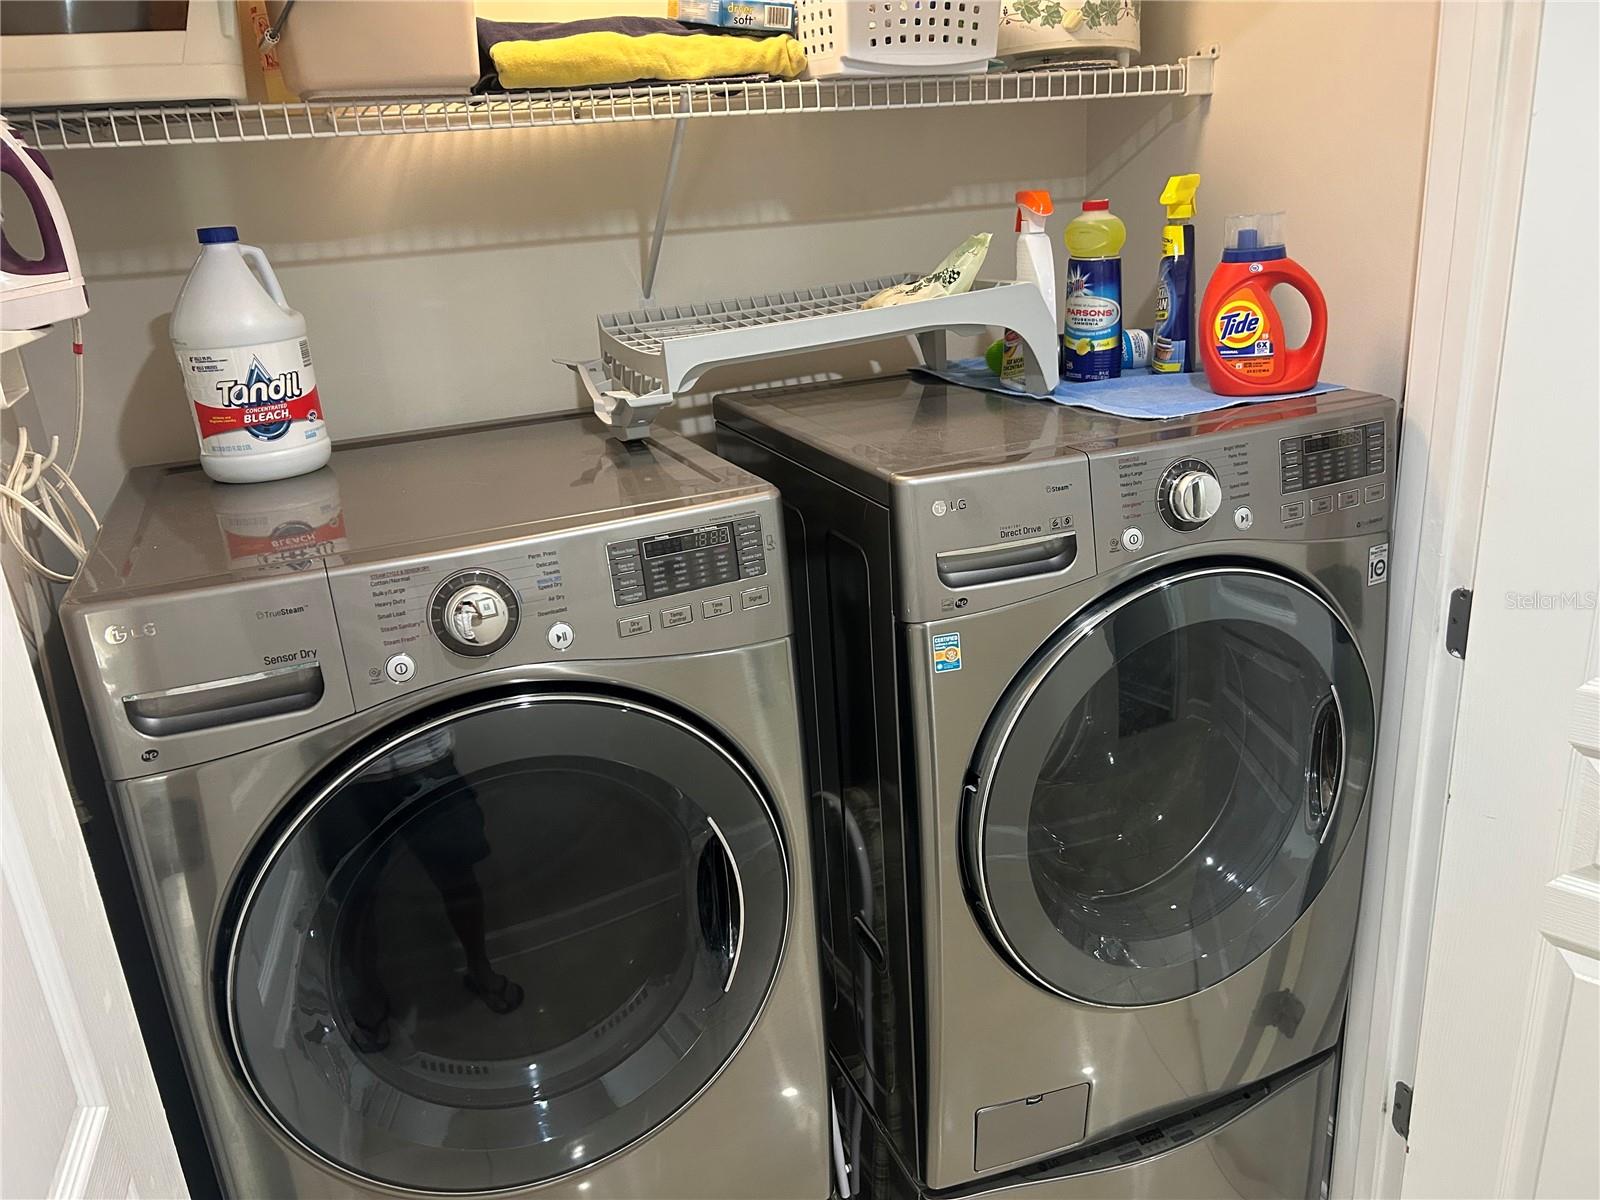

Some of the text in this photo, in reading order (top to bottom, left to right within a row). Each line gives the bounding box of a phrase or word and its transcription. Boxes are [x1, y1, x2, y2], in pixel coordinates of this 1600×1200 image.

[727, 2, 754, 17] dryer
[733, 14, 754, 26] soft
[1220, 312, 1260, 341] Tide
[1256, 341, 1268, 349] 6X
[216, 371, 303, 408] Tandil
[245, 403, 288, 414] CONCENTRATED
[243, 409, 289, 424] BLEACH
[950, 498, 967, 512] LG
[1000, 526, 1042, 538] Direct Drive
[370, 576, 411, 588] Cotton/Normal
[372, 588, 406, 598] Bulky/Large
[748, 594, 763, 603] Signal
[393, 598, 406, 606] Duty
[377, 610, 407, 620] Small Load
[713, 607, 722, 615] Dry
[630, 620, 640, 628] Dry
[668, 616, 688, 625] Control
[628, 626, 644, 634] Level
[264, 648, 318, 666] Sensor Dry
